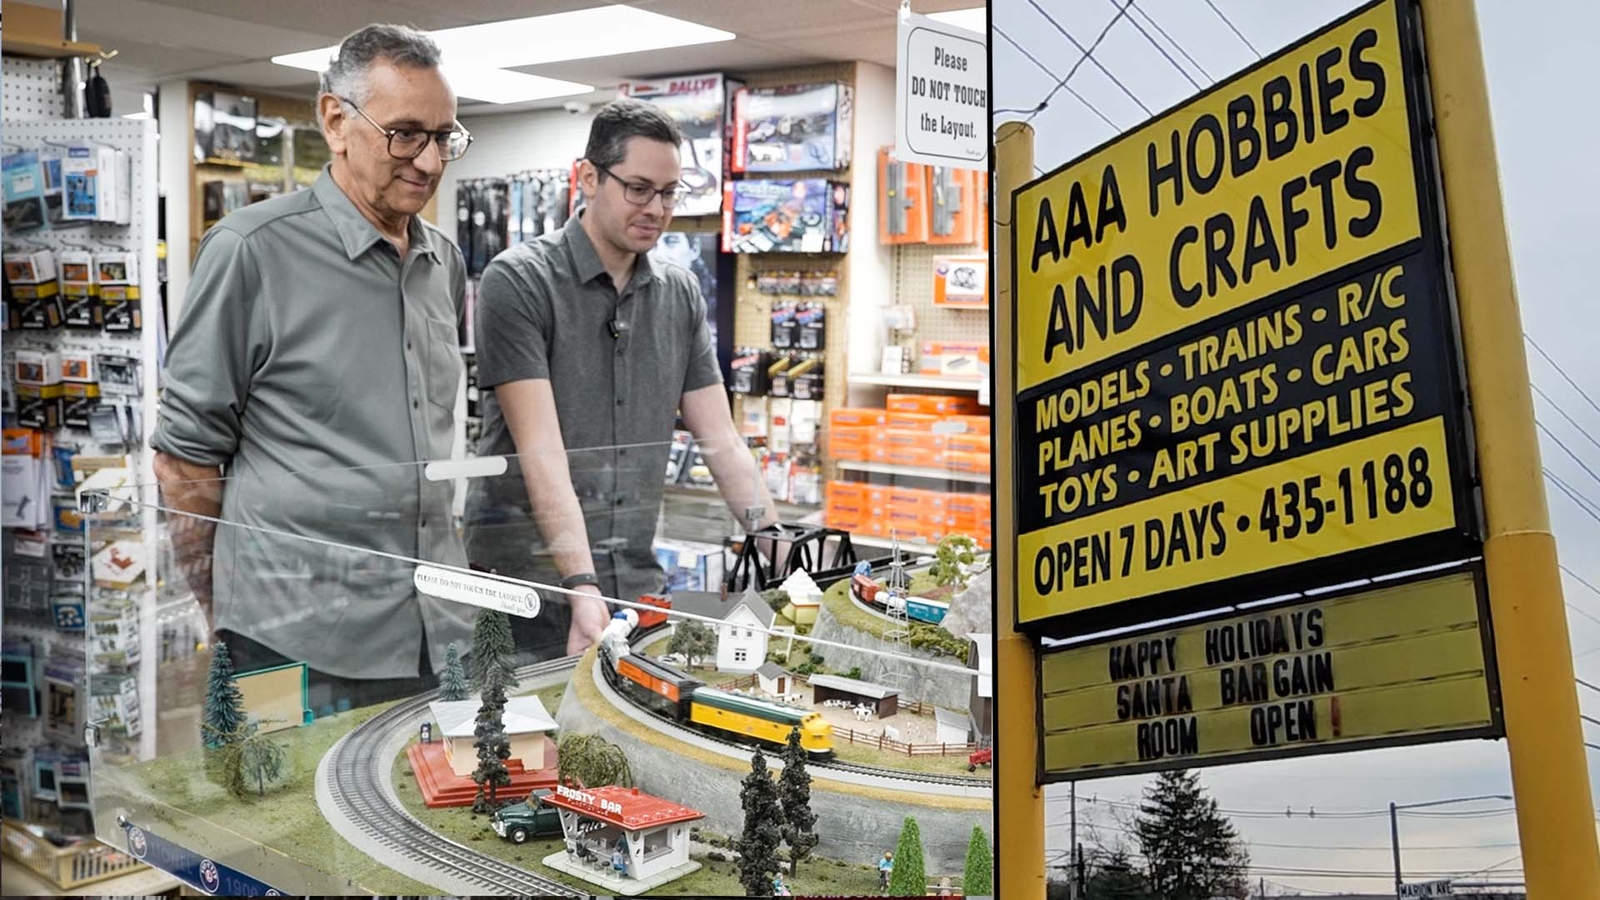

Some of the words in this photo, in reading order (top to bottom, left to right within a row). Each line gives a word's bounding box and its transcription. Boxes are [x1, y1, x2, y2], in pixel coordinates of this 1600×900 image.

[911, 75, 926, 97] DO
[929, 79, 950, 101] NOT
[953, 84, 986, 108] TOUCH
[934, 46, 968, 72] Please
[920, 113, 937, 133] the
[940, 115, 977, 140] Layout.
[1031, 164, 1127, 273] AAA
[1147, 28, 1387, 217] HOBBIES
[1044, 254, 1144, 364] AND
[1169, 146, 1382, 308] CRAFTS
[1035, 360, 1151, 434] MODELS
[1178, 304, 1303, 380] TRAINS
[1338, 265, 1406, 326] R/C
[1038, 411, 1142, 476] PLANES
[1170, 364, 1279, 433] BOATS
[1312, 318, 1410, 386] CARS
[1039, 464, 1118, 519] TOYS
[1148, 431, 1220, 489] ART
[1230, 372, 1415, 465] SUPPLIES
[1033, 530, 1112, 596] OPEN
[1120, 525, 1135, 578] 7
[1144, 501, 1226, 572] DAYS
[1259, 446, 1433, 543] 435-1188
[1109, 636, 1178, 682] HAPPY
[1205, 608, 1324, 666] HOLIDAYS
[1116, 675, 1193, 720] SANTA
[1220, 652, 1335, 707] BARGAIN
[1137, 716, 1198, 760] ROOM
[1250, 700, 1317, 746] OPEN
[556, 784, 596, 805] FROSTY
[600, 798, 623, 815] BAR
[1400, 884, 1432, 897] MARION
[1436, 880, 1452, 894] AVE
